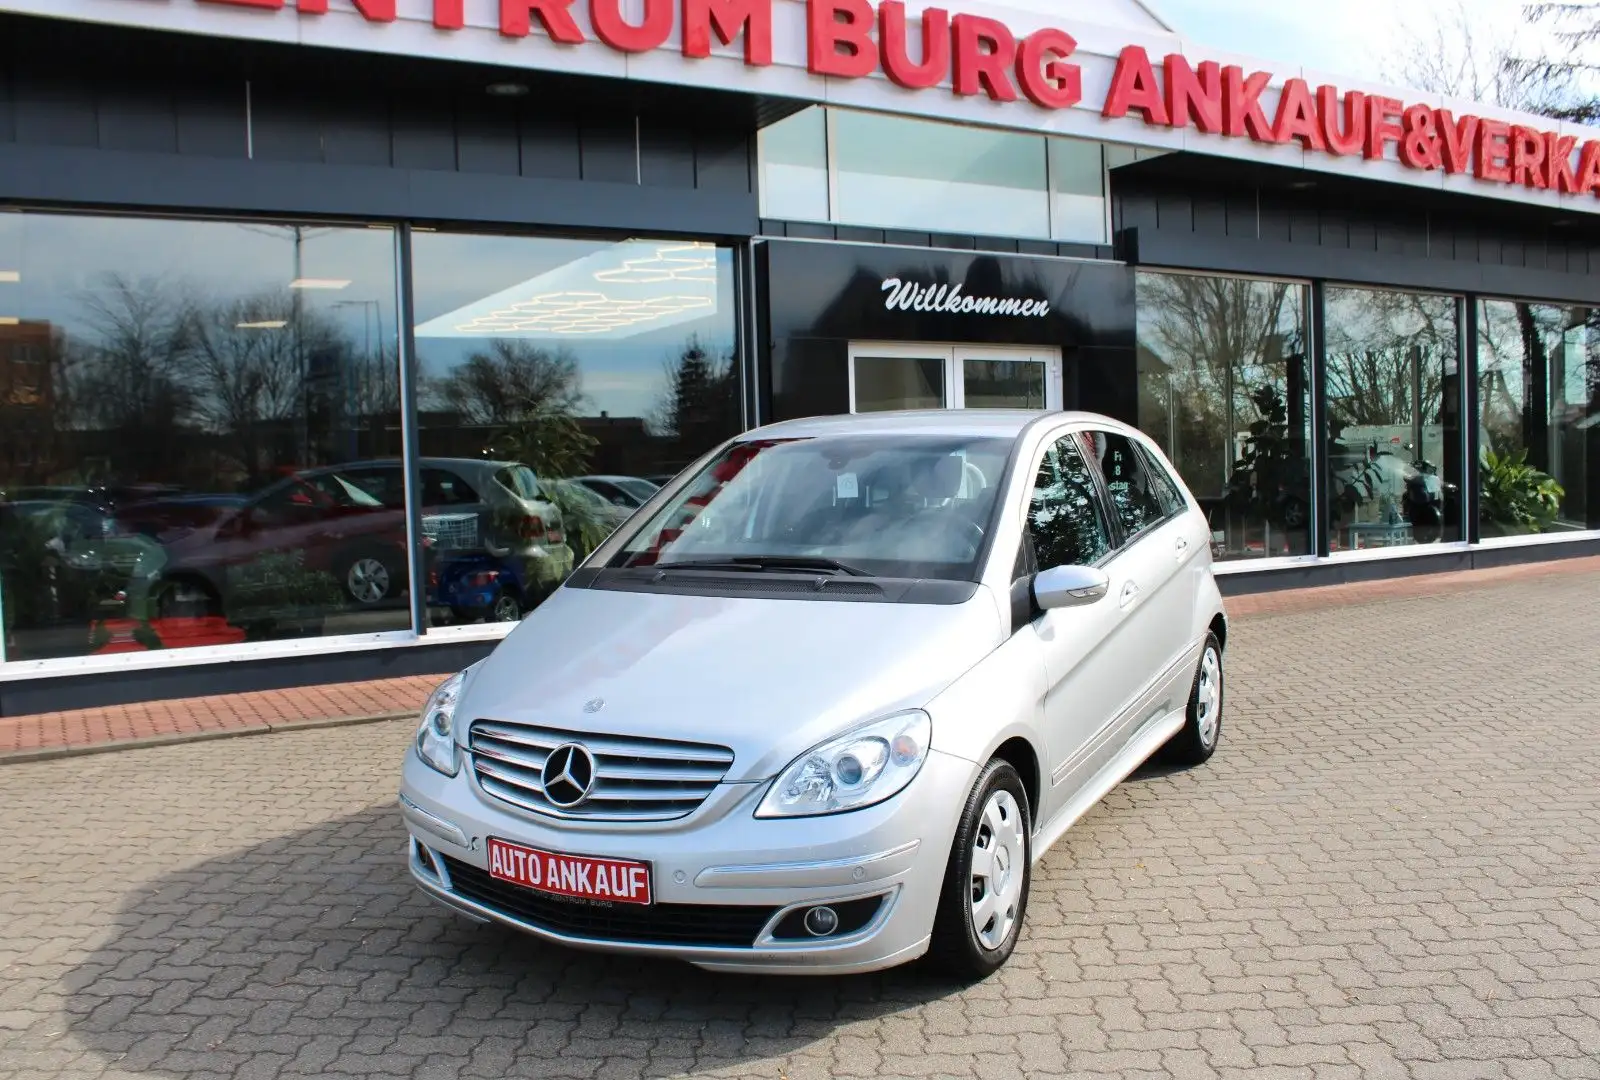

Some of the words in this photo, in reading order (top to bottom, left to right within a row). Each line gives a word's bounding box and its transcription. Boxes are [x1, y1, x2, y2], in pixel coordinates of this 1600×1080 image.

[806, 0, 1081, 109] BURG
[881, 277, 1050, 317] Willkommen
[492, 844, 542, 885] AUTO
[547, 857, 645, 898] ANKAUF
[590, 900, 613, 909] BURG
